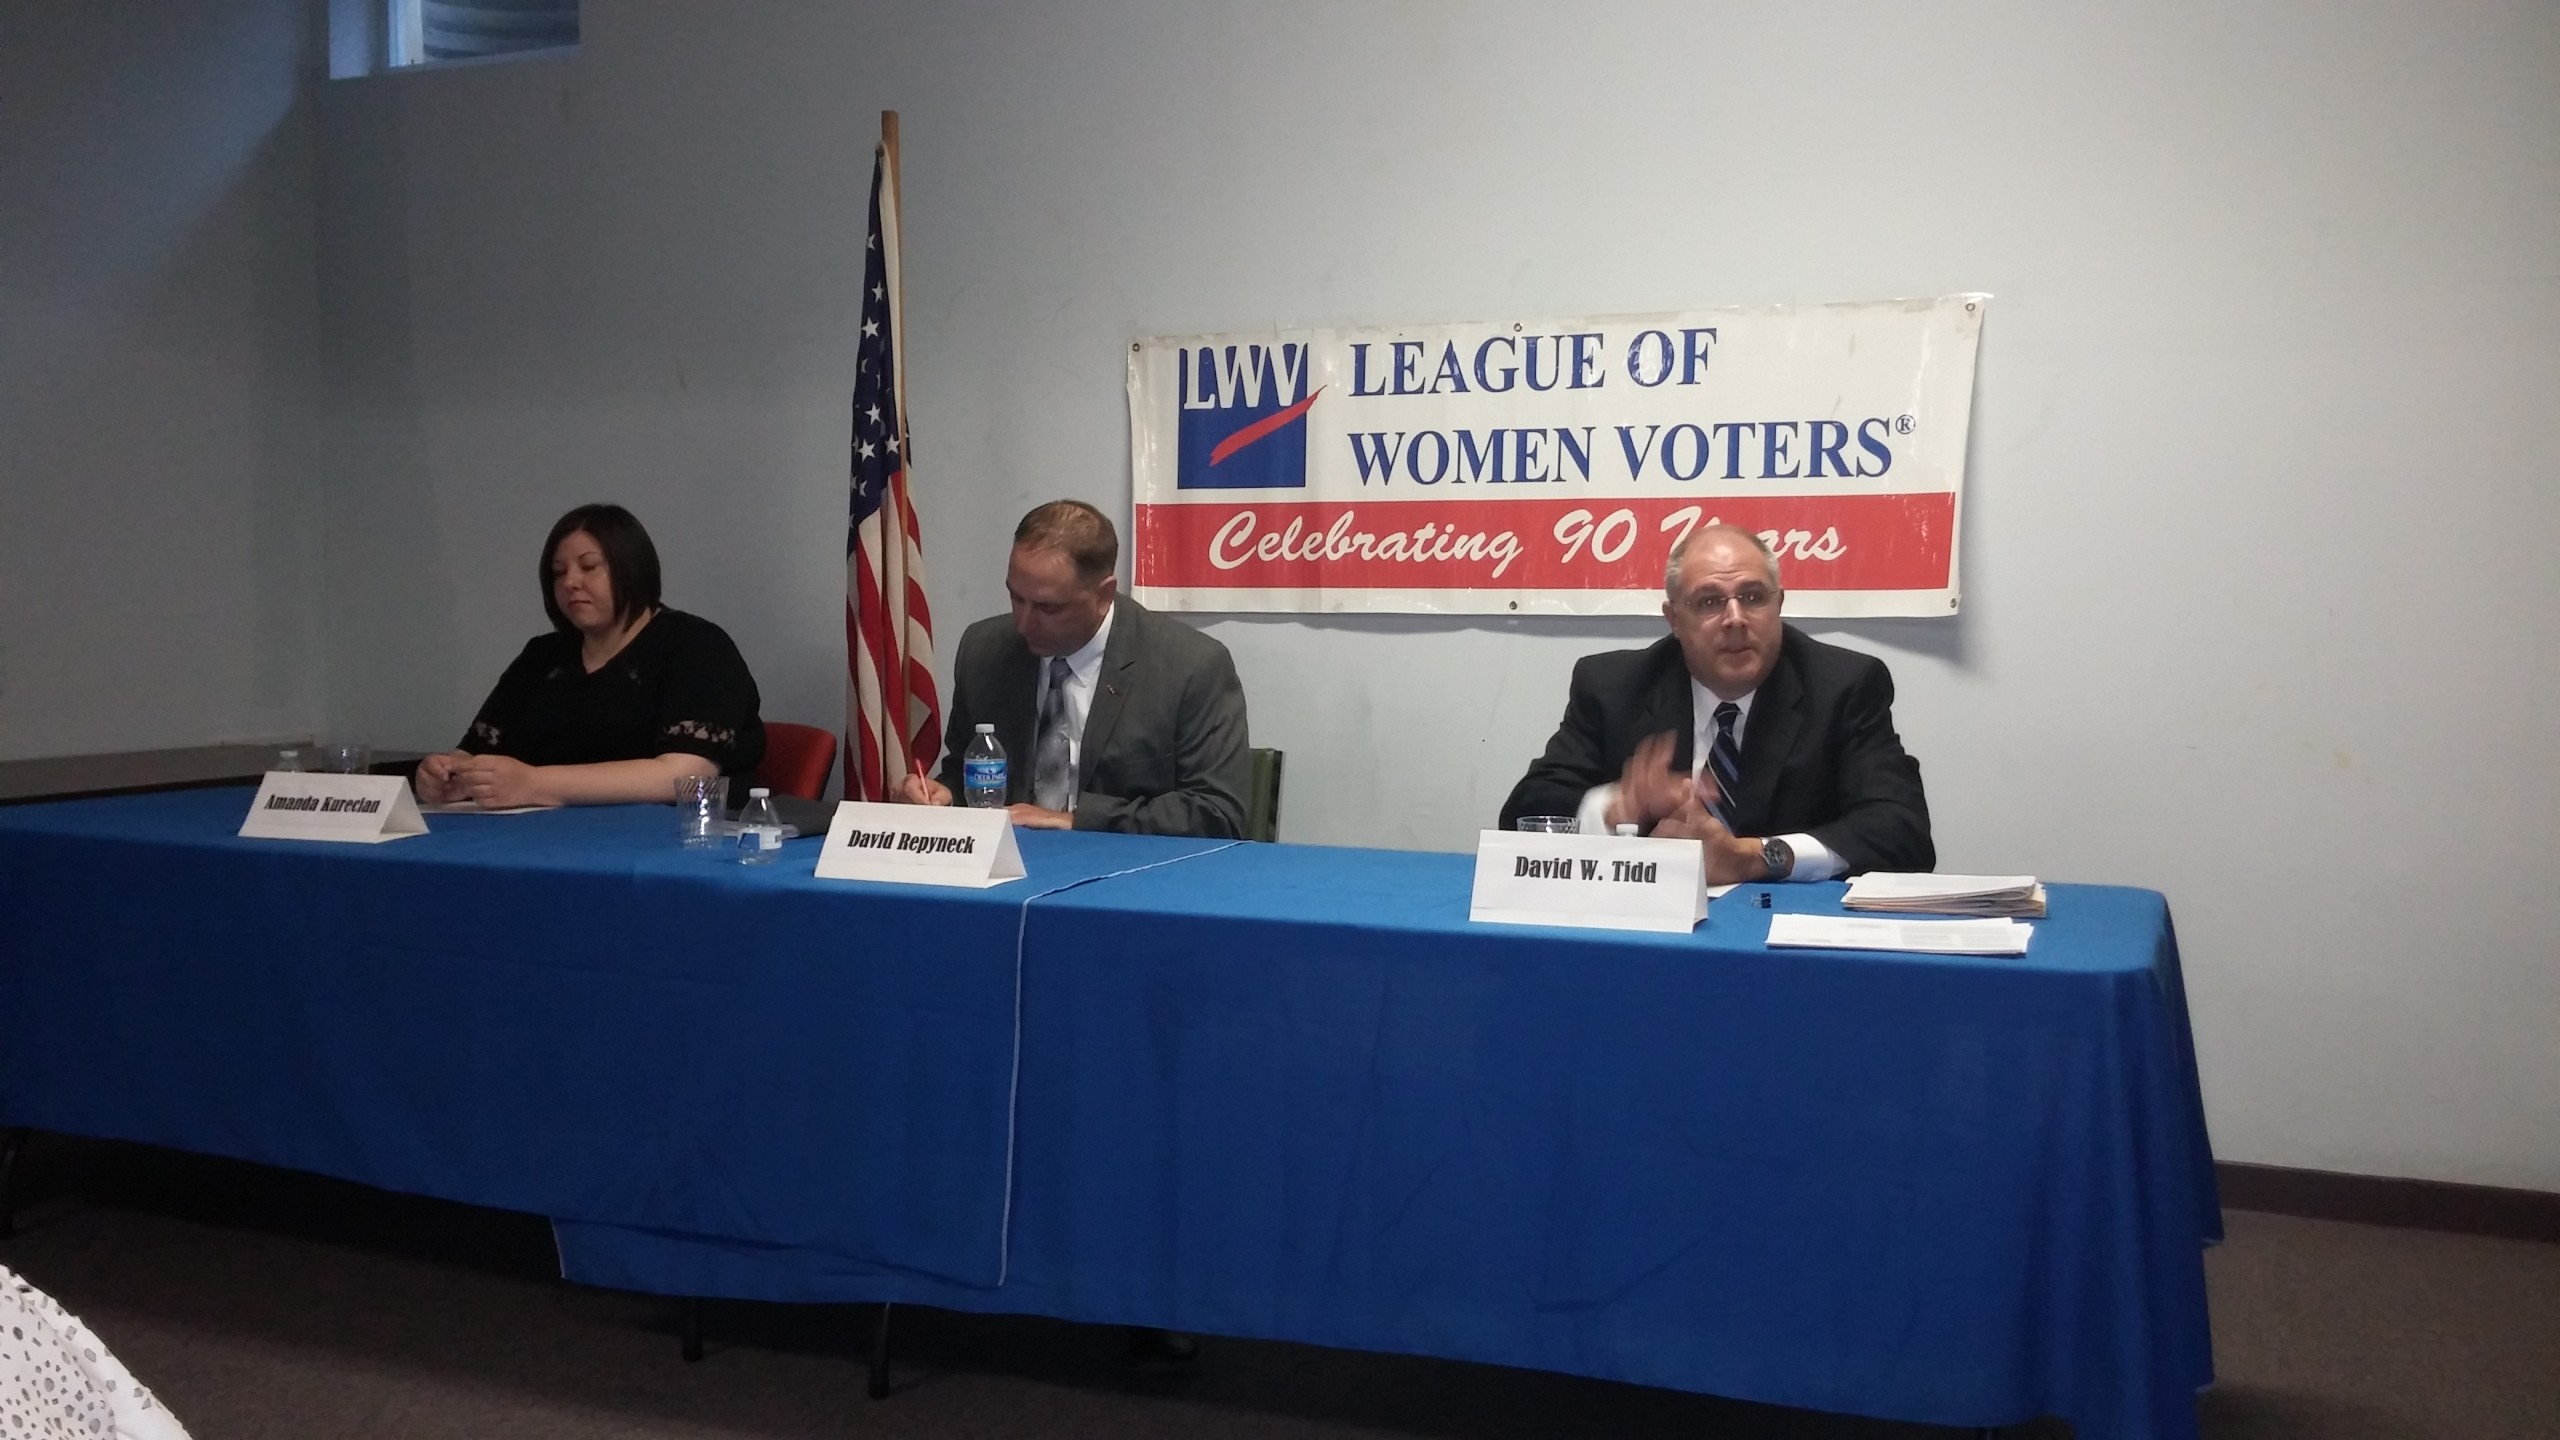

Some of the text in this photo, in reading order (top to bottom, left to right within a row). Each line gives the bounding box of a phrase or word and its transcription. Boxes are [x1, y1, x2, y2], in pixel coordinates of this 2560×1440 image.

[1348, 327, 1717, 397] LEAGUE OF
[1347, 426, 1597, 486] WOMEN
[1209, 510, 1524, 579] Celebrating
[1553, 508, 1638, 564] 90
[263, 793, 381, 814] Amanda Kurecian
[847, 829, 976, 854] David Repyneck
[1514, 855, 1657, 884] David W. Tidd
